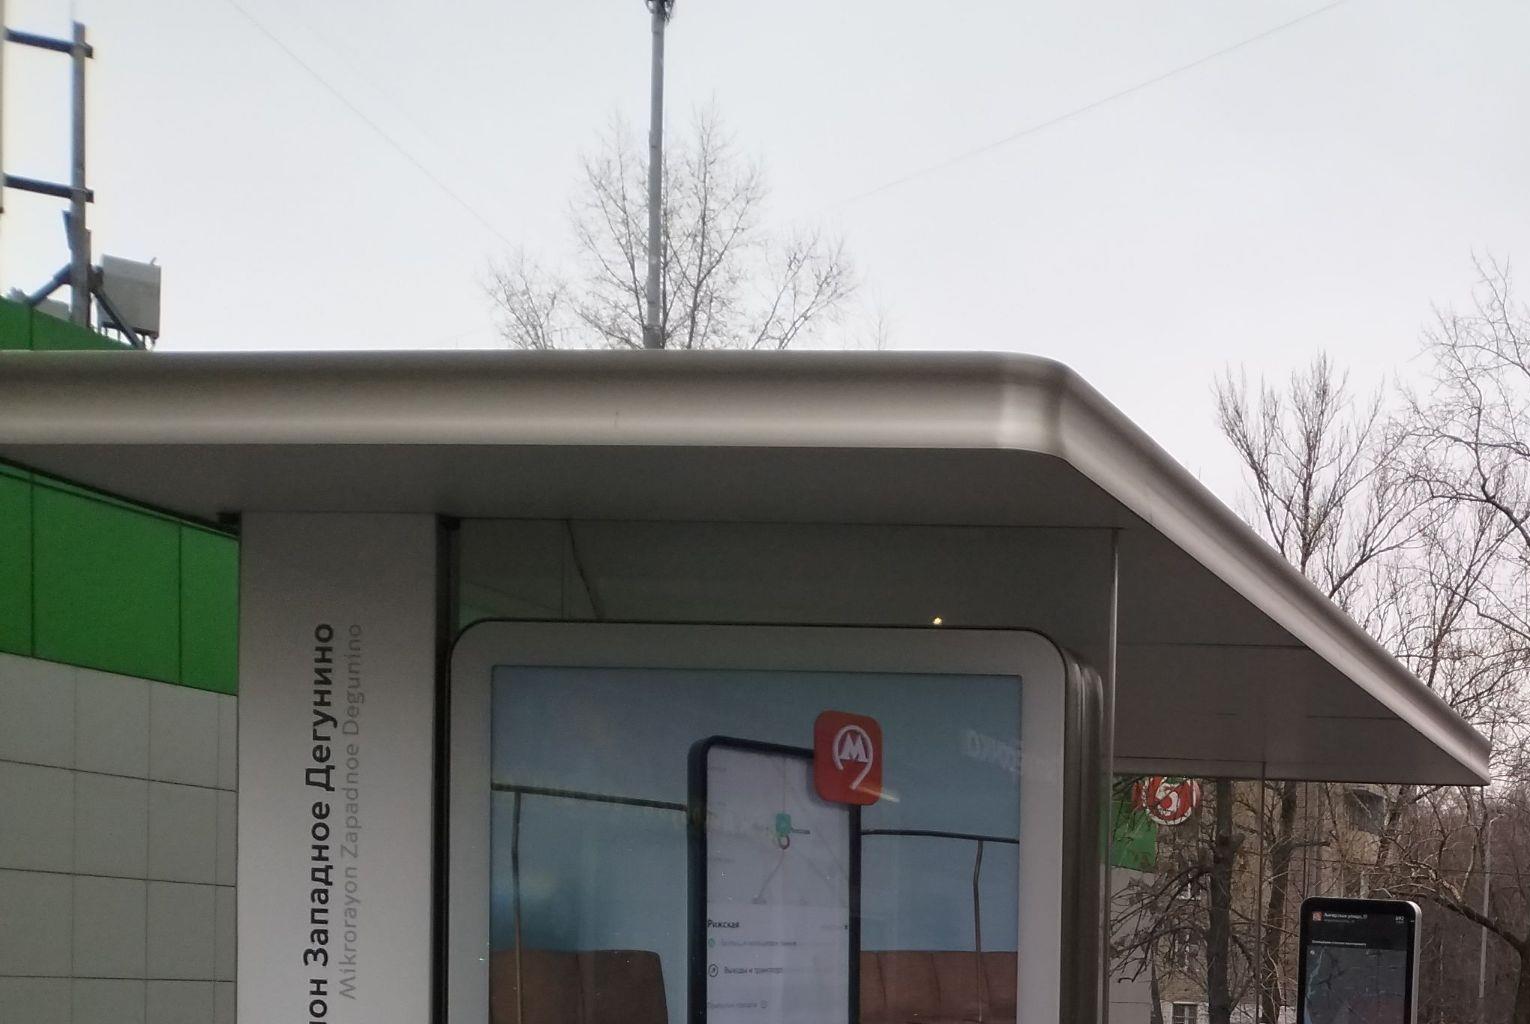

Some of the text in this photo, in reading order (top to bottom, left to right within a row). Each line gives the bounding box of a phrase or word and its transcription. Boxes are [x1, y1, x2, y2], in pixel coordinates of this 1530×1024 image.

[305, 623, 336, 792] Дегунино
[302, 802, 332, 967] Западное
[339, 624, 363, 1000] Mikrorayon Zapadnoe Degunino
